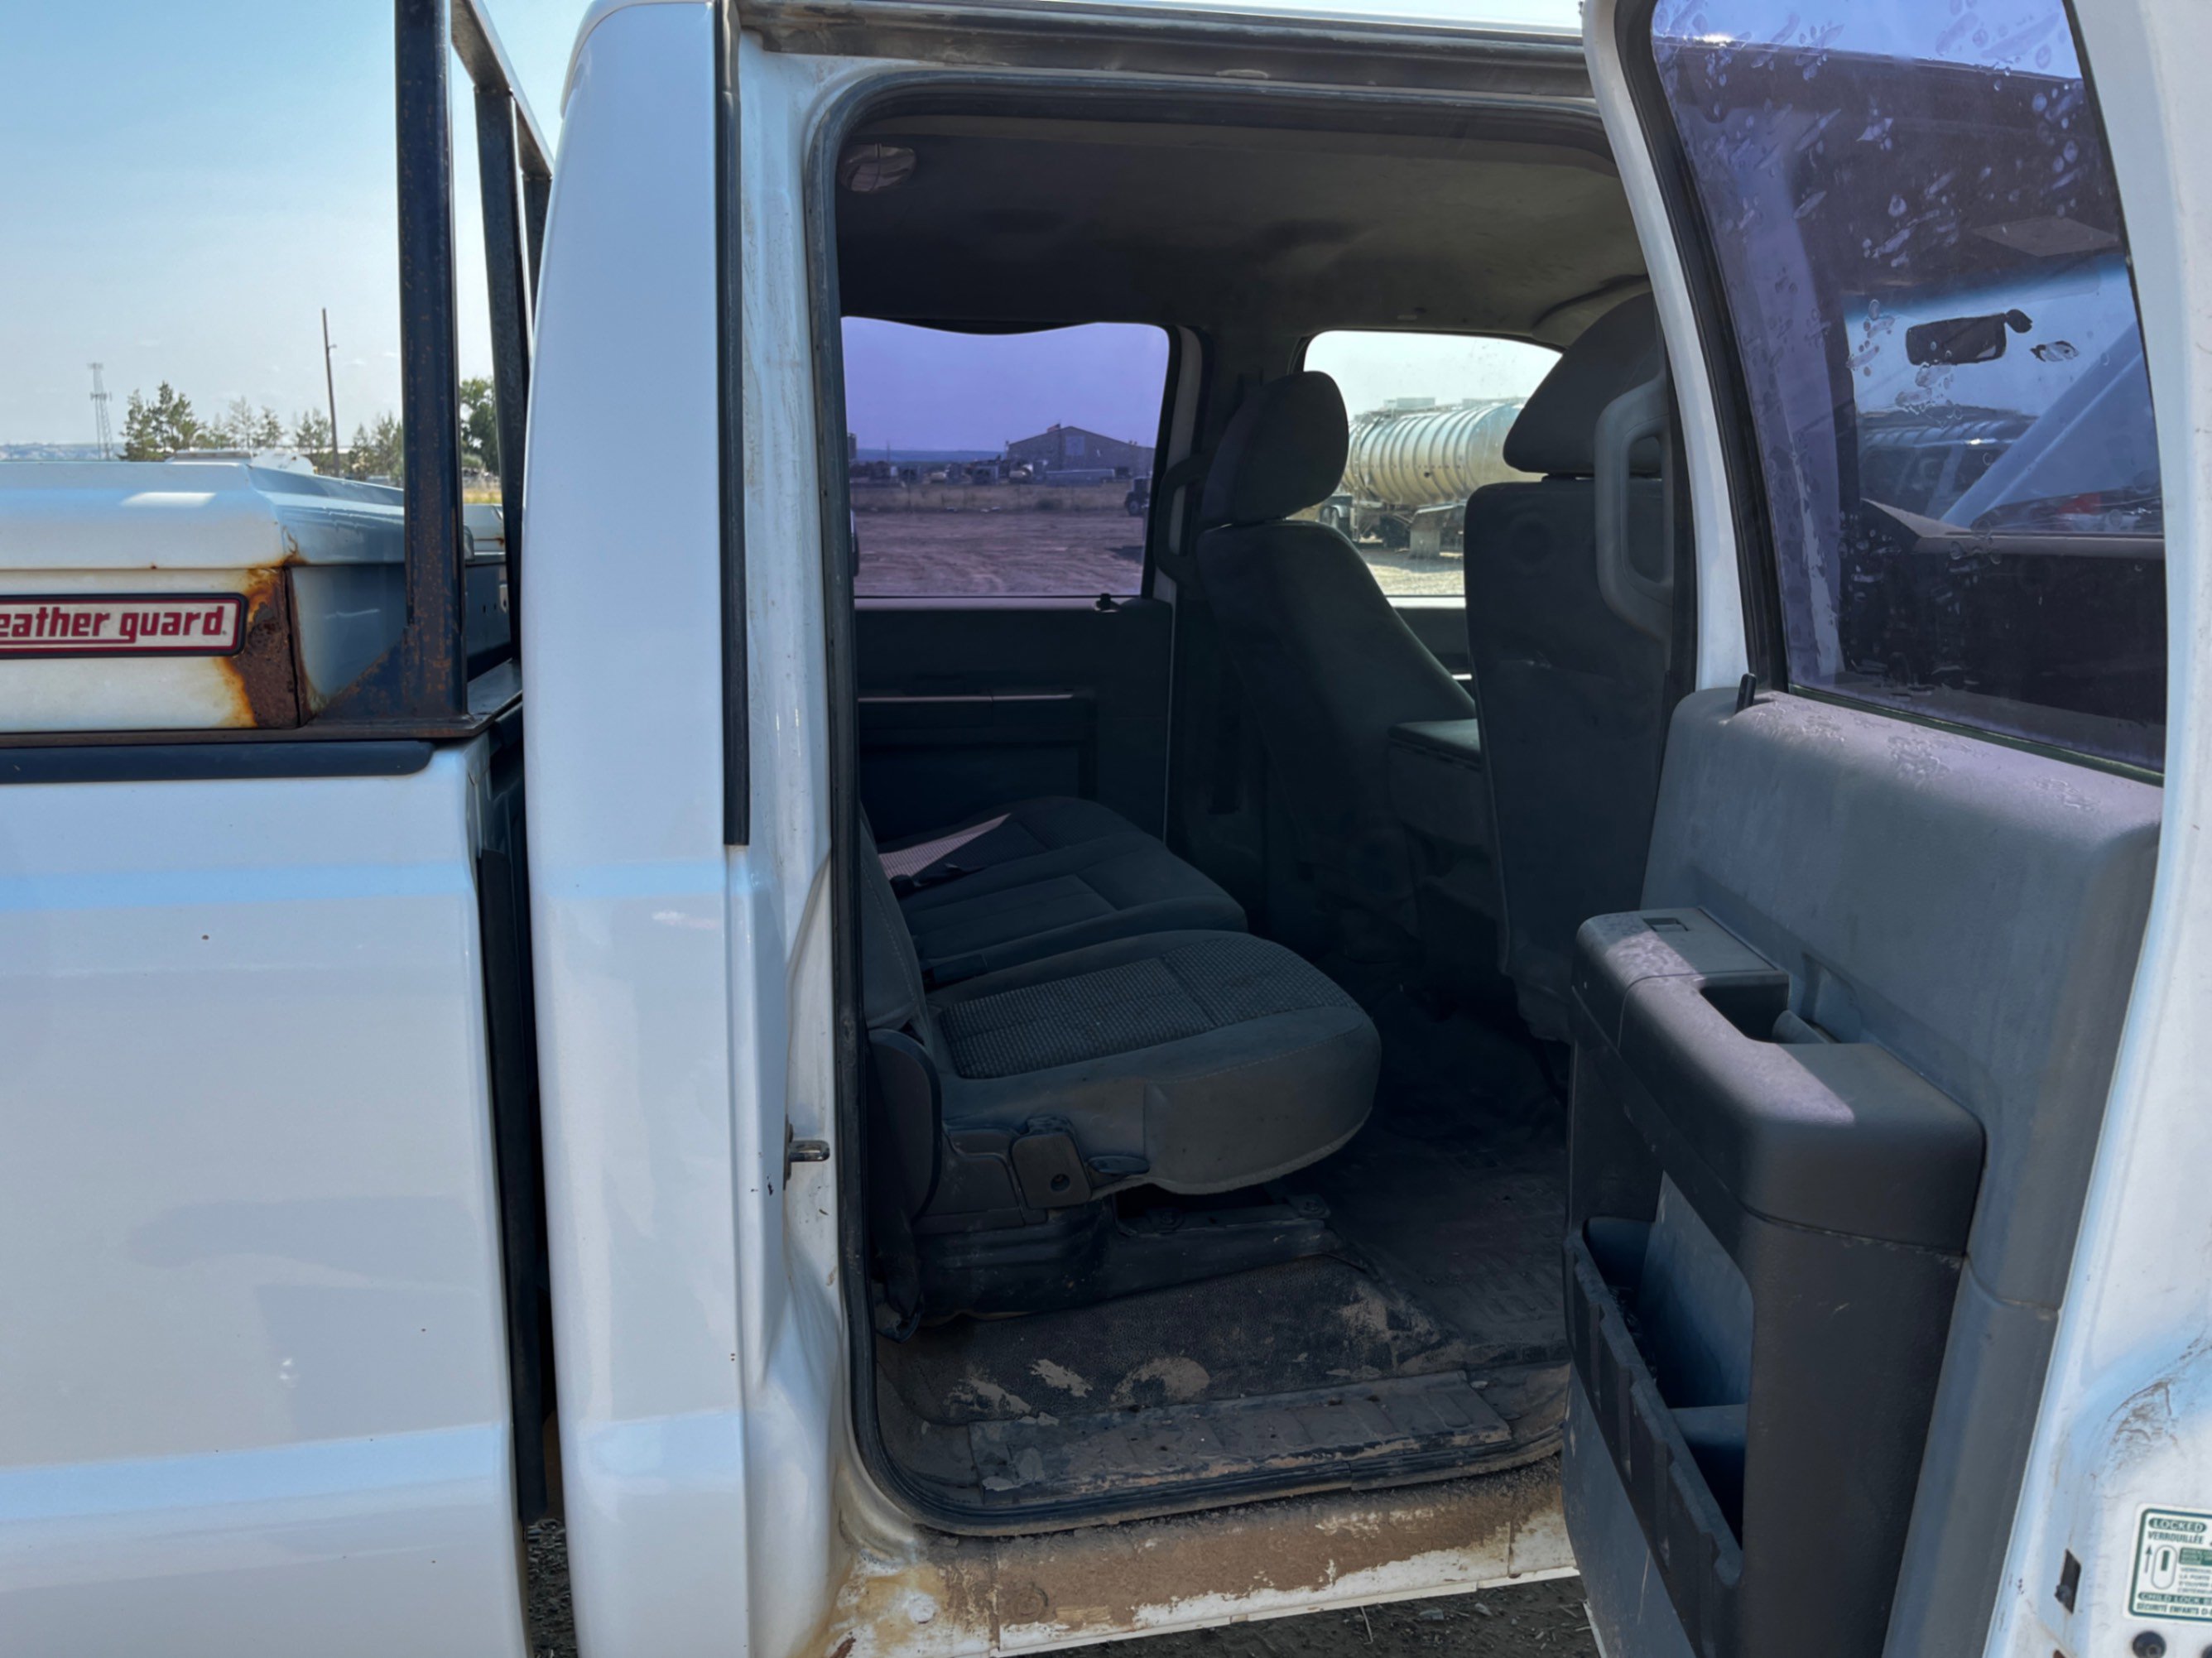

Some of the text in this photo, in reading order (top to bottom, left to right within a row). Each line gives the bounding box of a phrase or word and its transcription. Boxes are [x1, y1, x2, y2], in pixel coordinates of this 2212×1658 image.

[119, 606, 224, 643] guard
[2152, 1519, 2204, 1532] LOCKED
[2141, 1593, 2171, 1602] CHILD
[2174, 1596, 2200, 1604] LOCK
